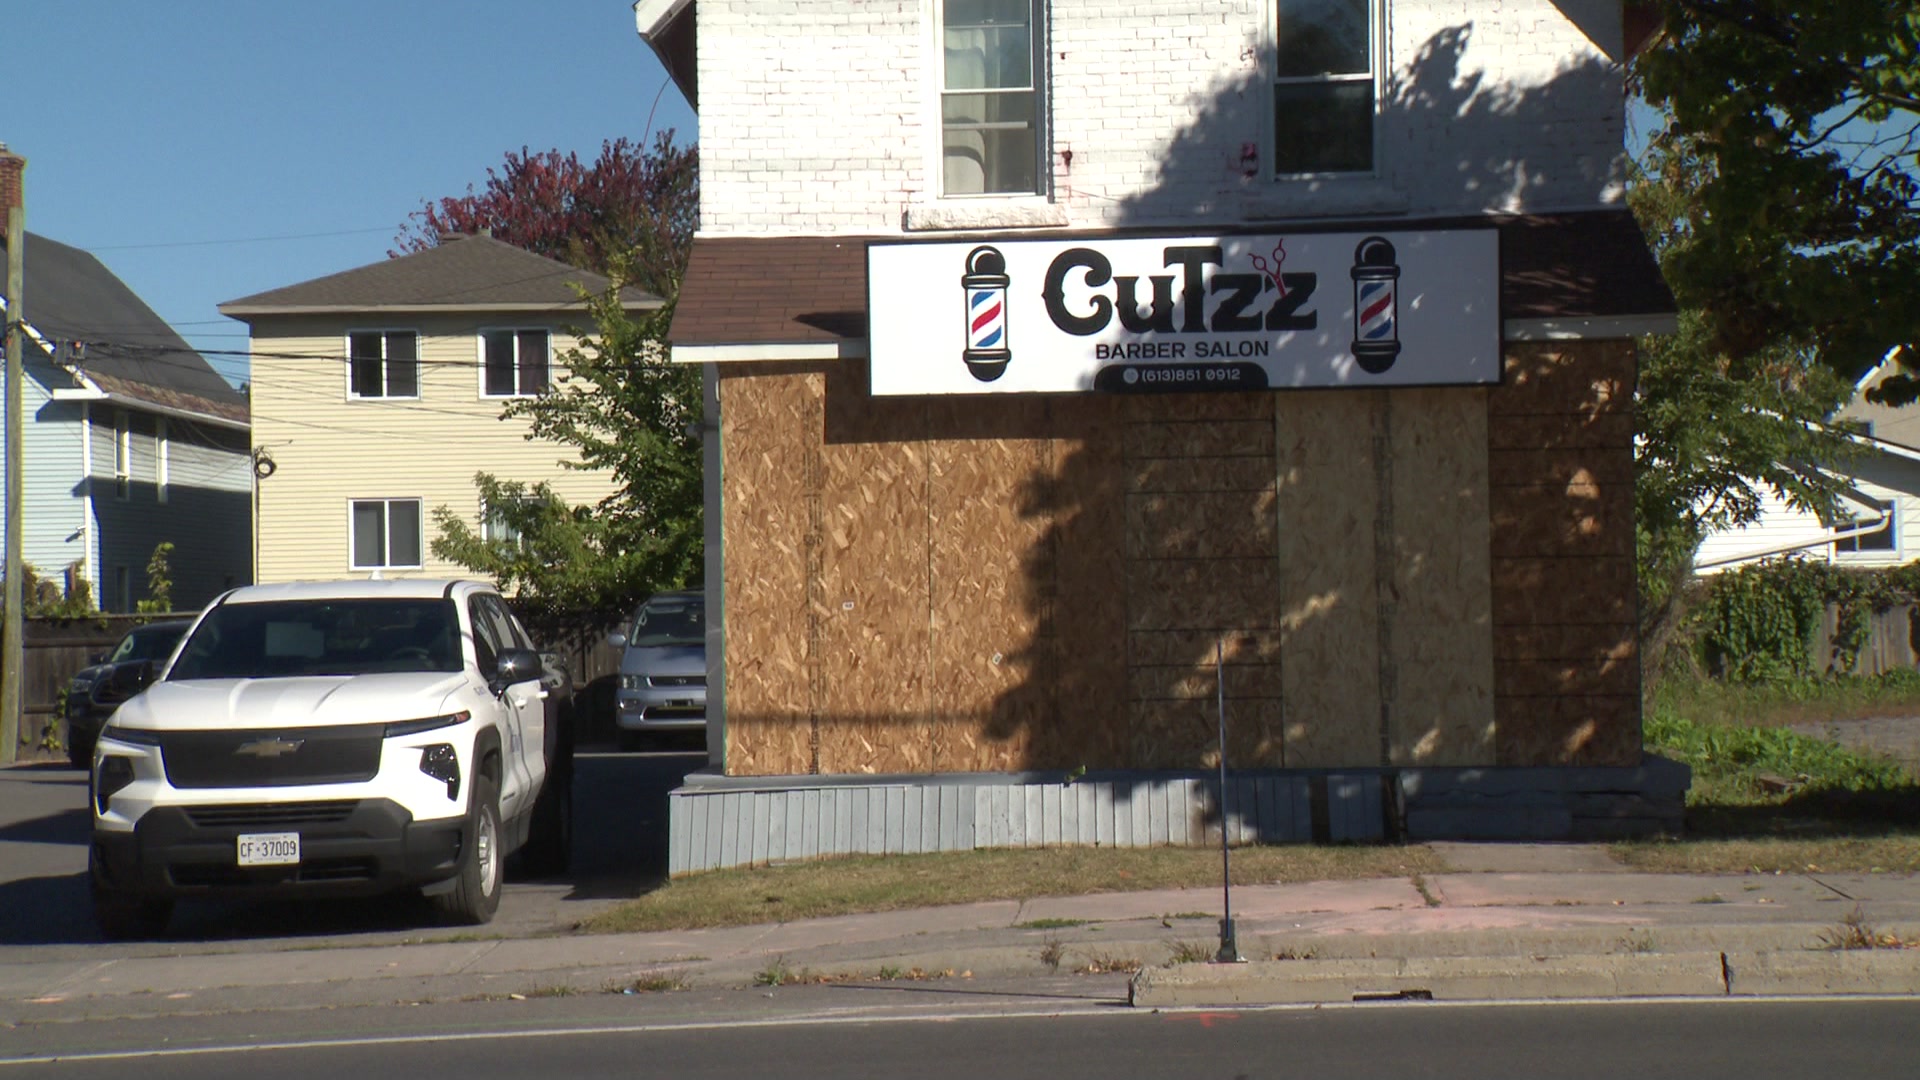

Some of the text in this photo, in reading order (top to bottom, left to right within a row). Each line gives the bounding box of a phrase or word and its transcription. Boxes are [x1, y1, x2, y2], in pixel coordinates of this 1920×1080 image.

[1095, 340, 1269, 360] BARBER SALON
[1141, 368, 1241, 382] (613)851 0912
